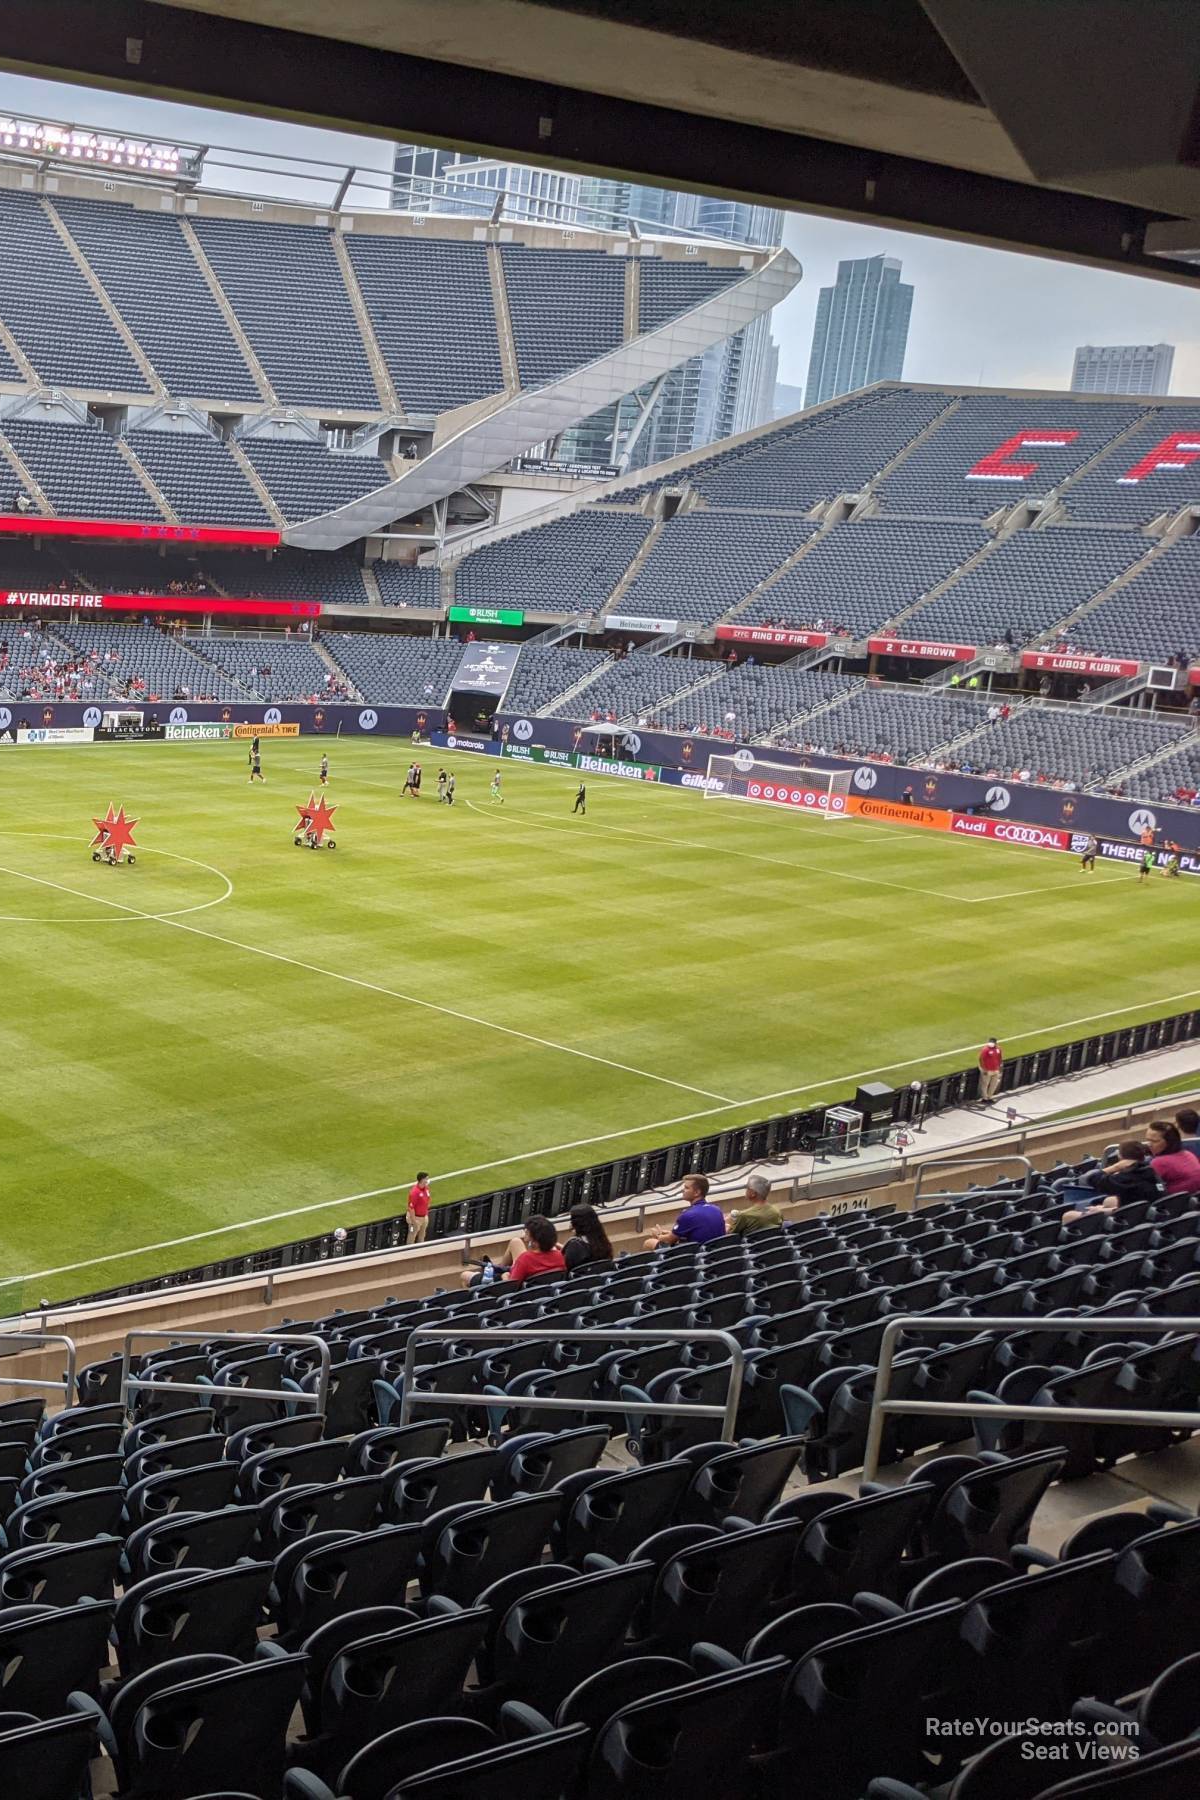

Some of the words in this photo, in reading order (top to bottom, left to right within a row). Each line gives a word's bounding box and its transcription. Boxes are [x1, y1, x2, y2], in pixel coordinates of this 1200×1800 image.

[105, 182, 115, 192] 443
[413, 216, 424, 225] 445
[6, 592, 104, 607] #VAMOSFIRE
[476, 609, 498, 618] RUSH
[620, 621, 652, 630] Heineken
[752, 631, 773, 641] RING
[775, 634, 786, 642] OF
[789, 635, 809, 644] FIRE
[886, 643, 893, 652] 2
[901, 644, 918, 654] C.J.
[920, 646, 956, 658] BROWN
[1037, 657, 1044, 666] 5
[1052, 659, 1087, 670] LUBOS
[1089, 662, 1122, 674] KUBIK
[165, 725, 220, 739] Heineken
[234, 723, 274, 737] Continental
[281, 726, 298, 734] TIRE
[457, 739, 485, 750] motorola
[512, 745, 530, 755] RUSH
[550, 751, 569, 761] RUSH
[581, 755, 643, 779] Heineken
[681, 773, 725, 791] Gillette
[860, 801, 925, 822] Continental
[955, 819, 987, 833] Audi
